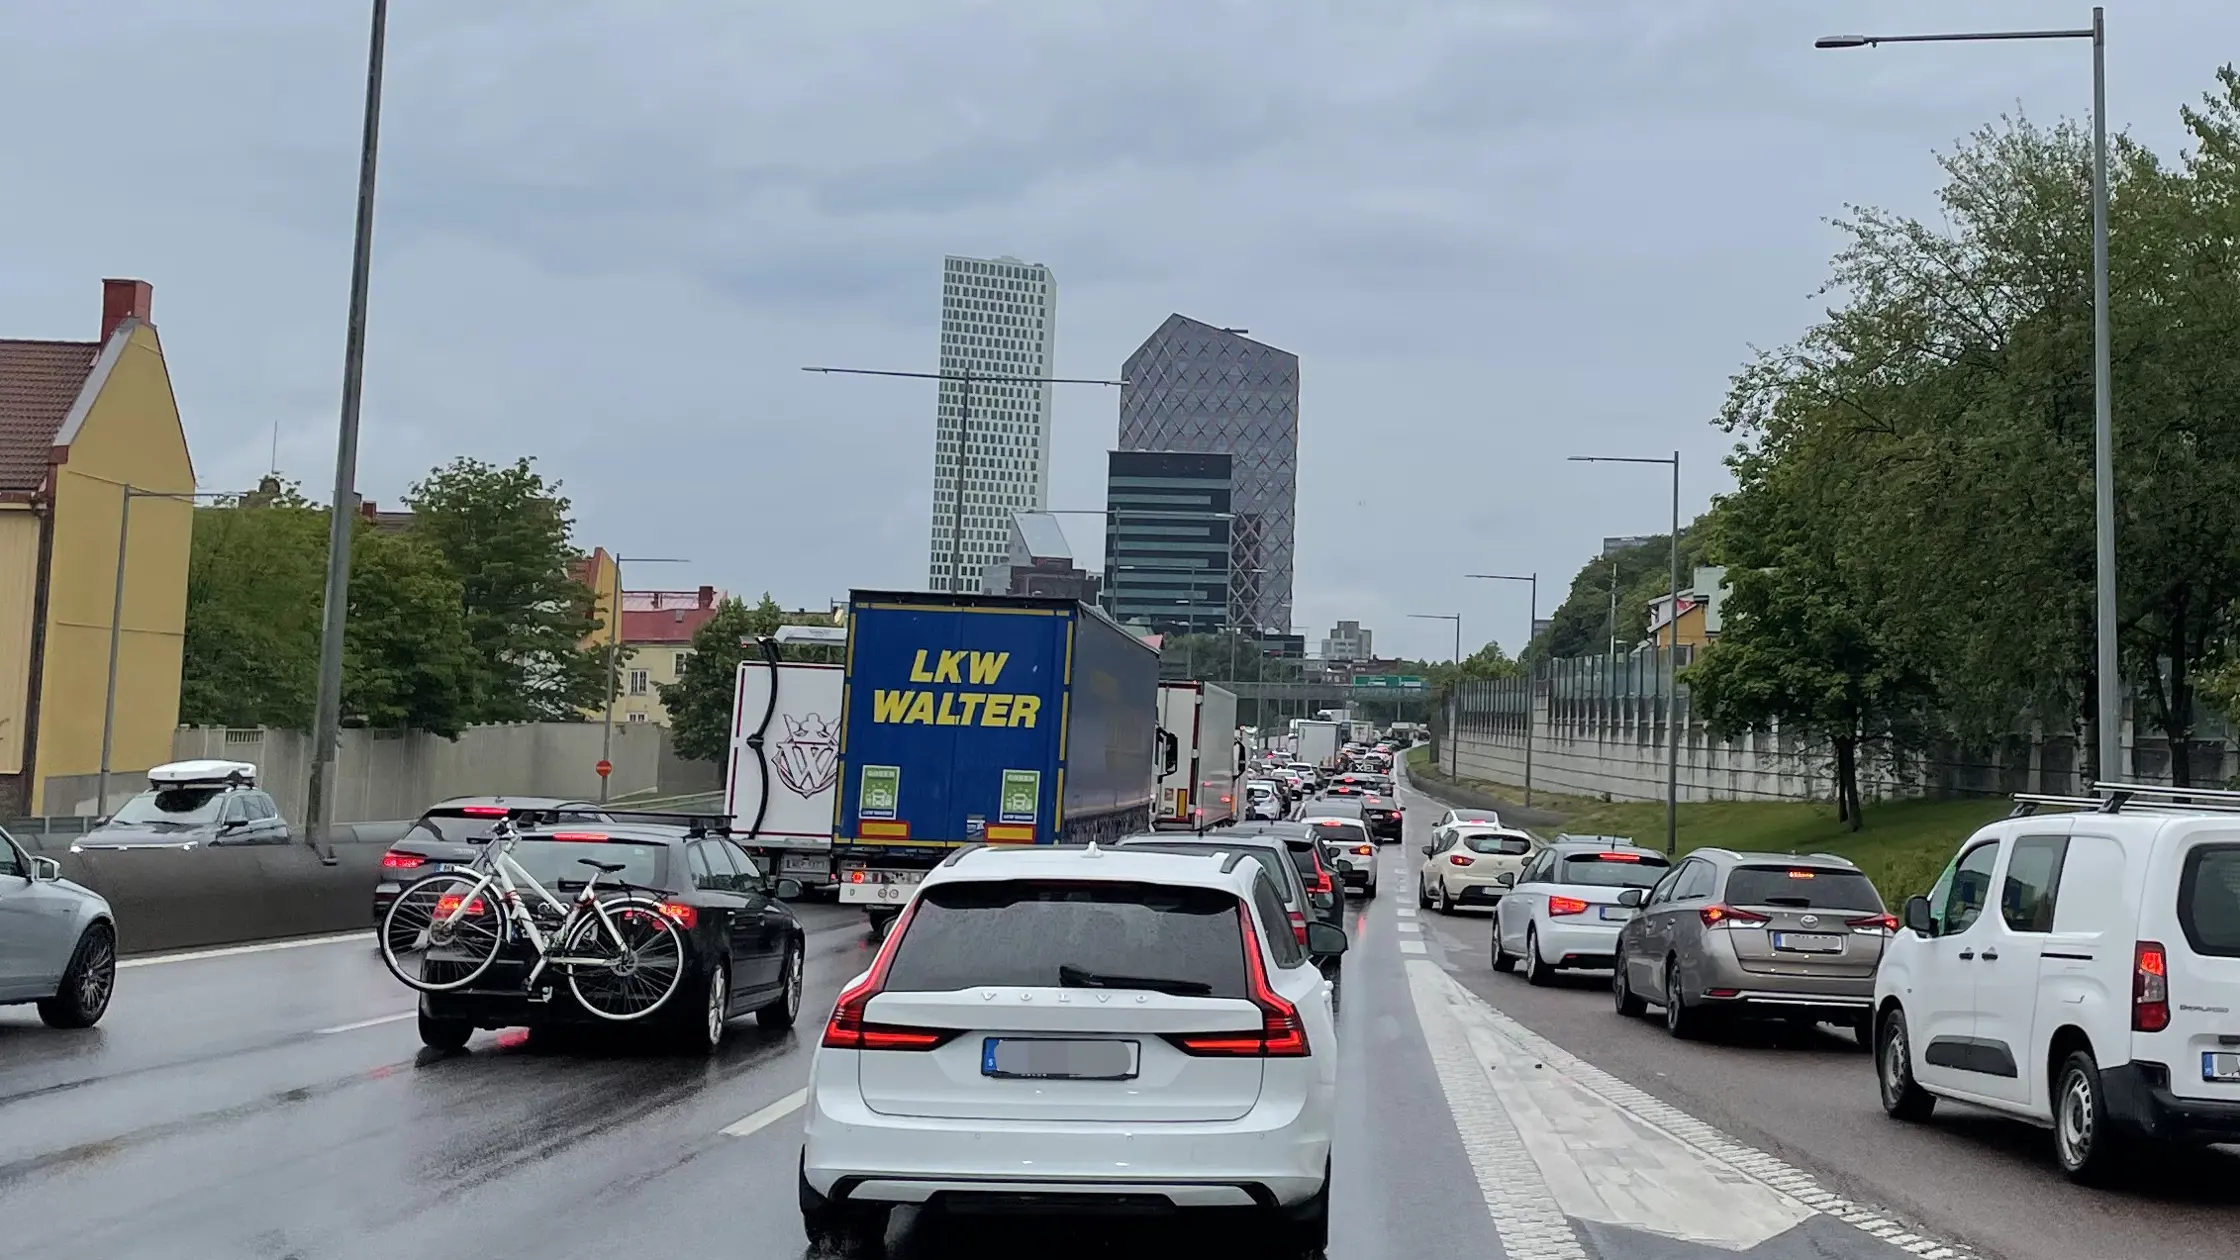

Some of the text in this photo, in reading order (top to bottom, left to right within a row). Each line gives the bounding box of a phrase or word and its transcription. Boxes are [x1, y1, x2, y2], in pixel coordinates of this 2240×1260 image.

[909, 649, 1010, 685] LKW
[873, 689, 1041, 728] WALTER
[981, 991, 1148, 1004] VOLVO
